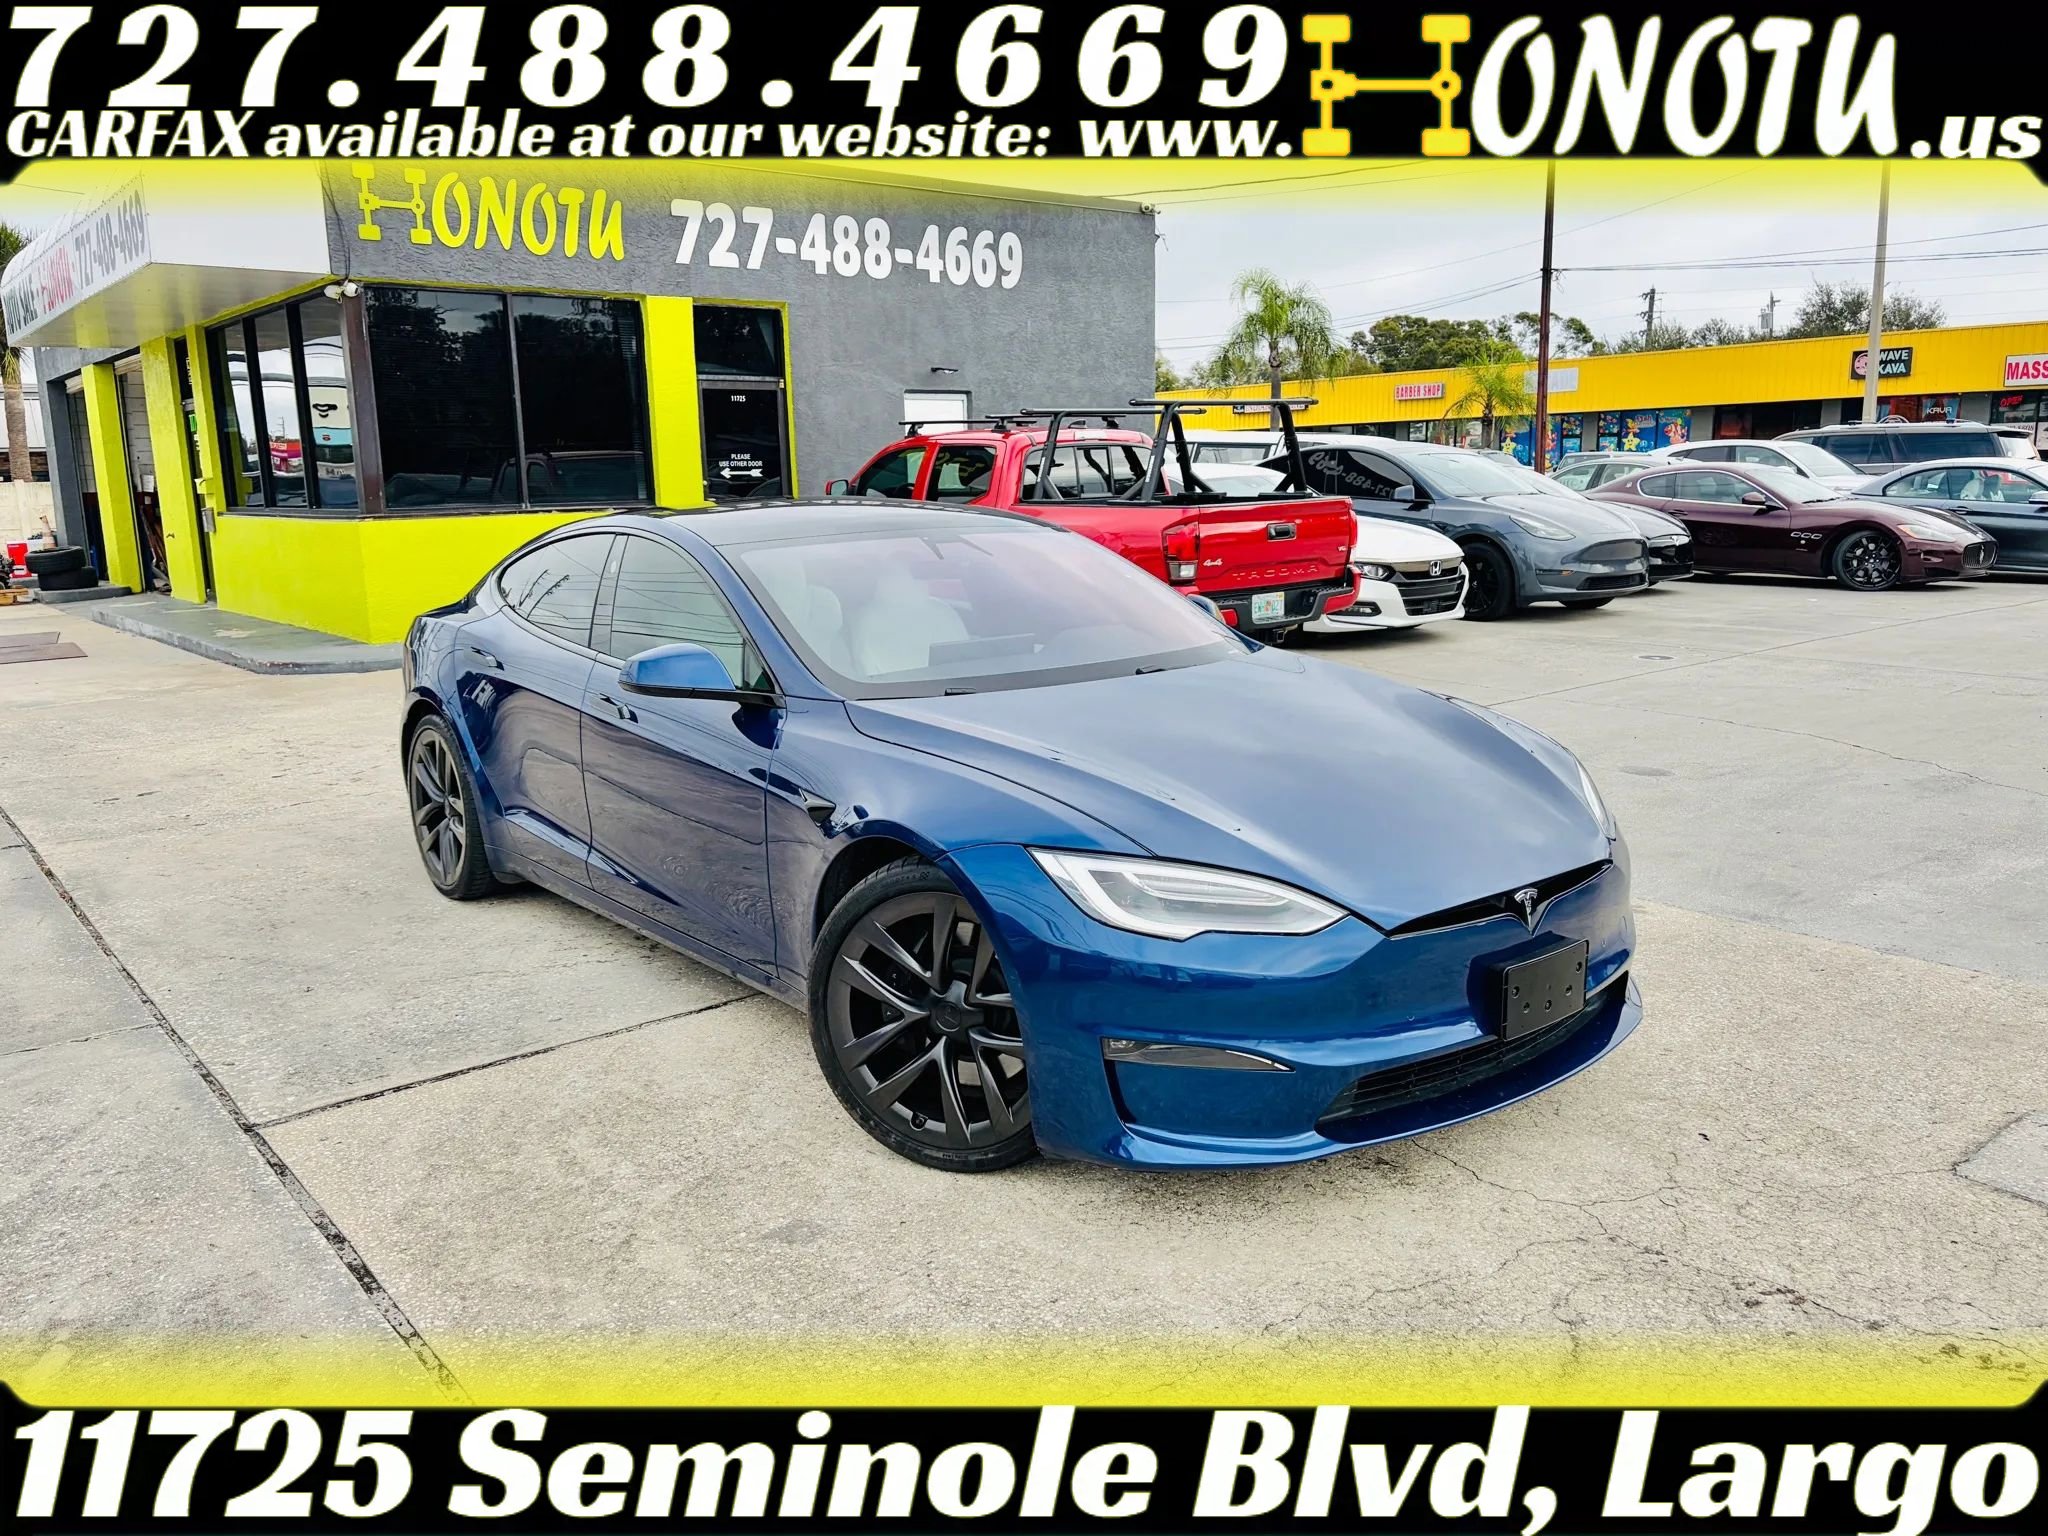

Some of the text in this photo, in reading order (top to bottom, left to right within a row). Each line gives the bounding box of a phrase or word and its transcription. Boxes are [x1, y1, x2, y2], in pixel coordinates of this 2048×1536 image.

[75, 189, 146, 291] 727-488-4669
[671, 199, 1023, 290] 727-488-4669
[1395, 383, 1441, 398] BARBER SHOP
[1232, 564, 1317, 580] TACOMA
